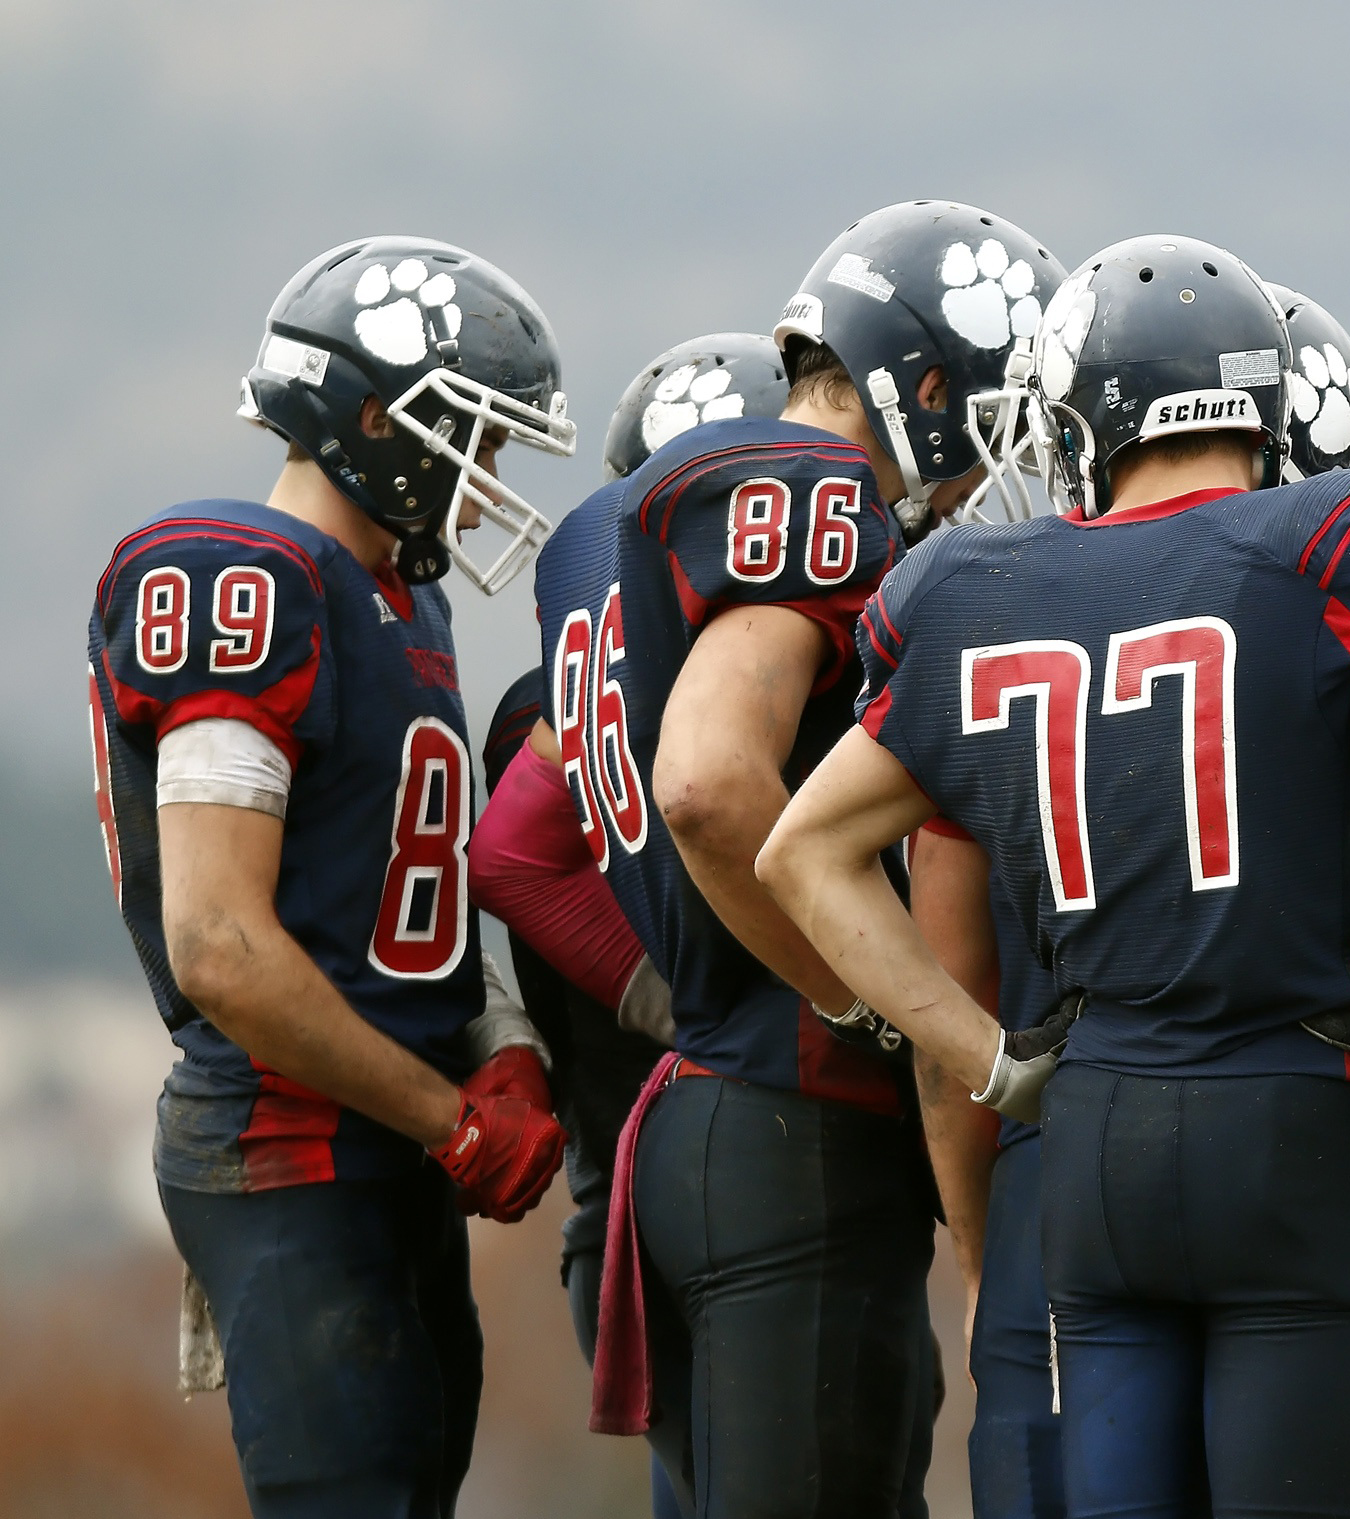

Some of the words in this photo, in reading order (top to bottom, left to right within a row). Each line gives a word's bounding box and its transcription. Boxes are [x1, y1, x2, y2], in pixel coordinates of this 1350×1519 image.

[1159, 398, 1247, 423] schutt
[726, 476, 862, 586] 86
[135, 565, 276, 674] 89
[553, 580, 649, 874] 86
[961, 615, 1240, 913] 77
